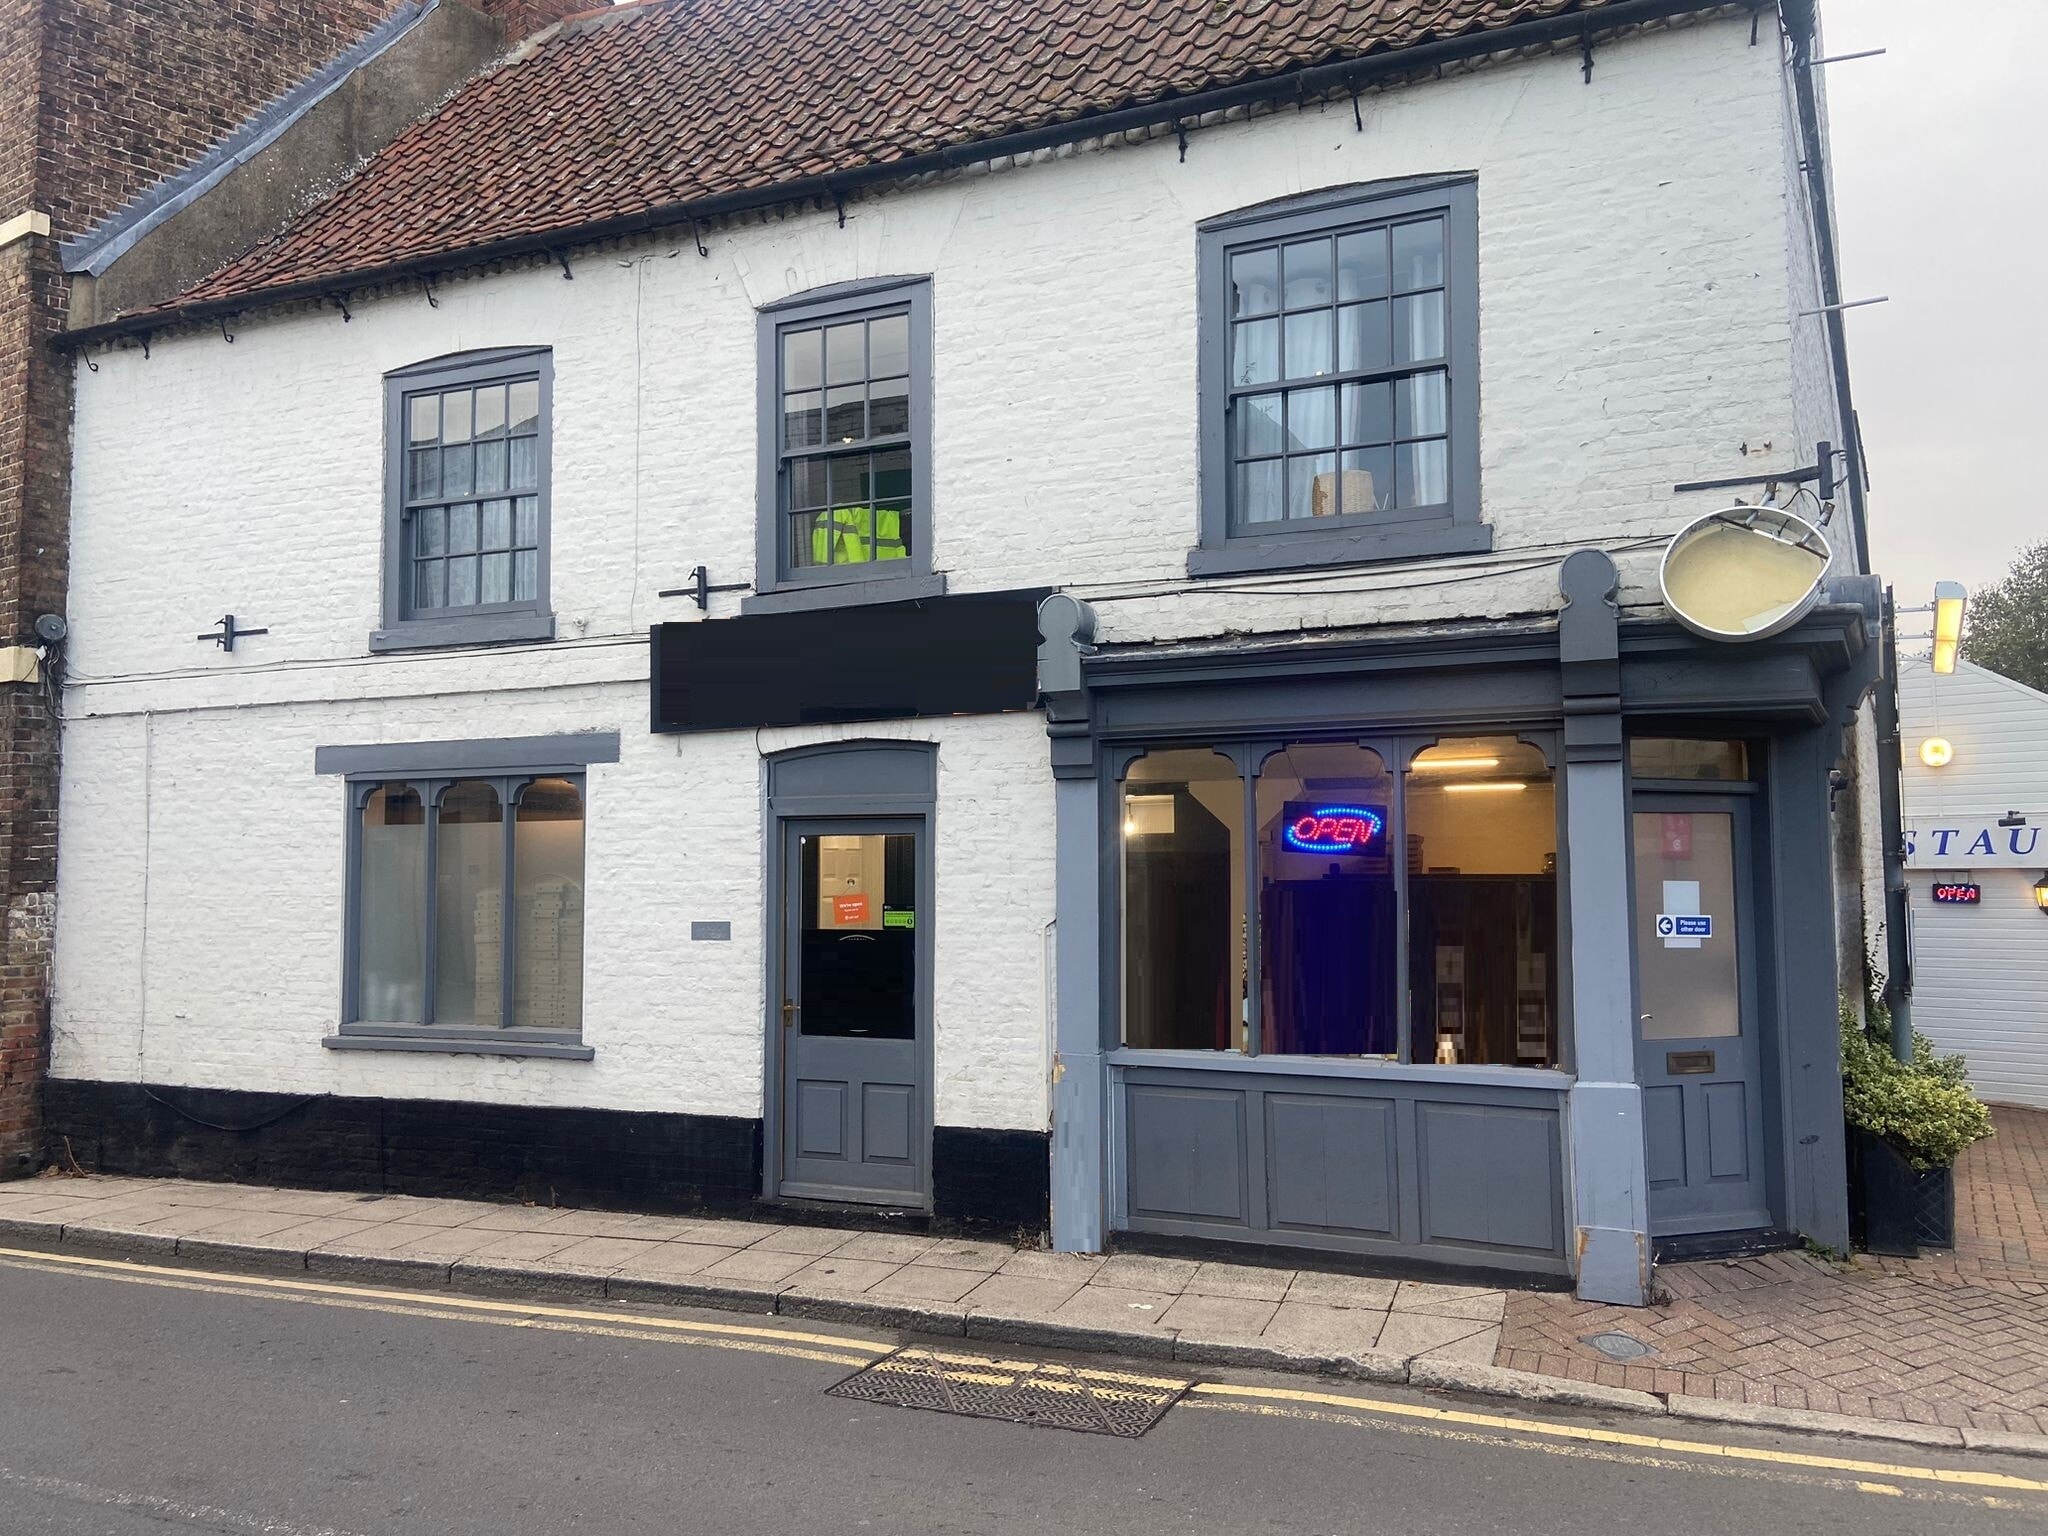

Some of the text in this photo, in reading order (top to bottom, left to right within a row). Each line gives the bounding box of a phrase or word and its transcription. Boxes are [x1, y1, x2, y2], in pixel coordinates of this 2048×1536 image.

[1295, 817, 1375, 843] OPEN
[1902, 828, 2041, 855] STAU
[1937, 887, 1976, 899] OPEN
